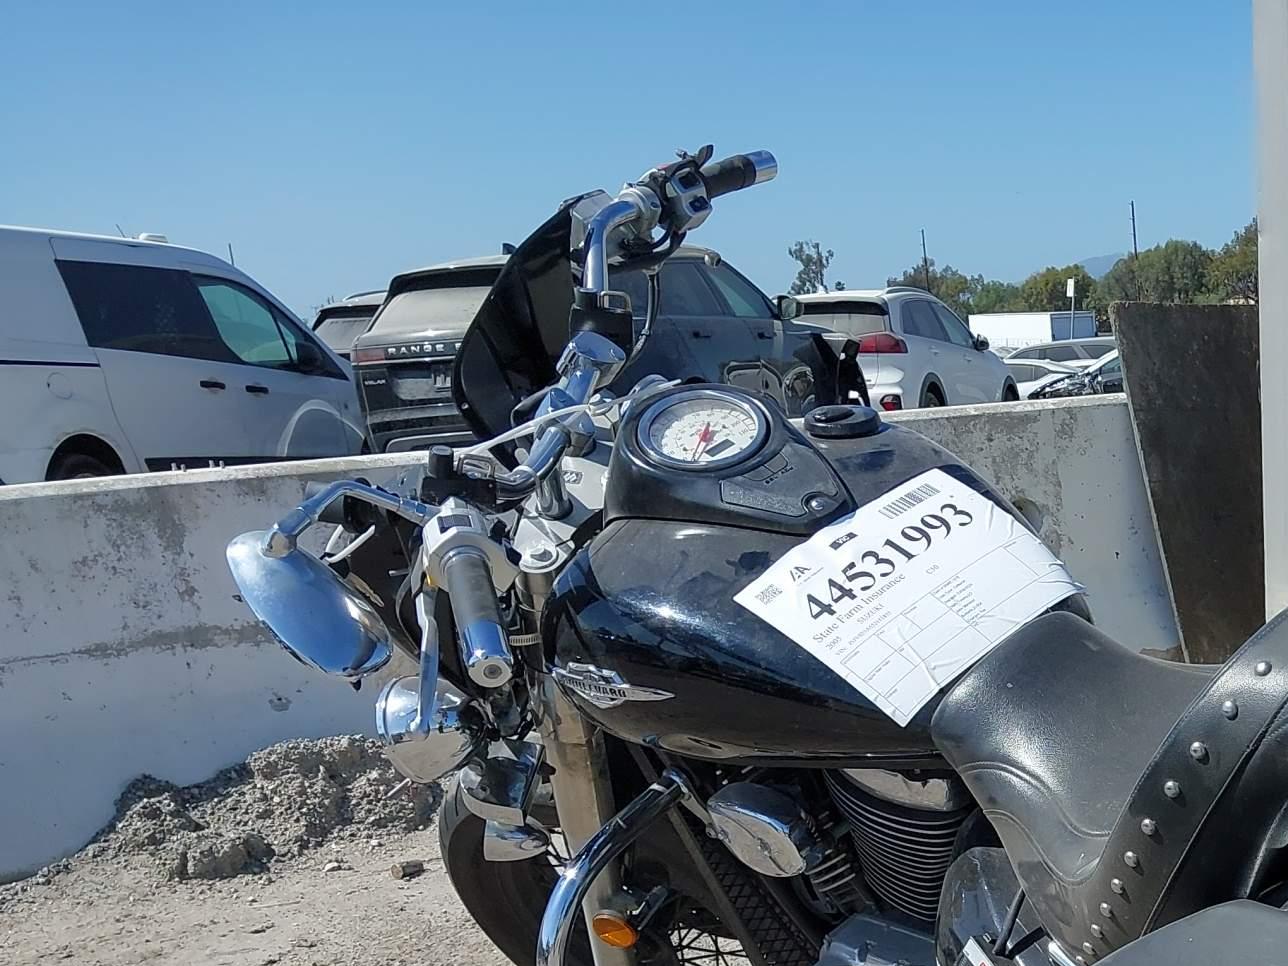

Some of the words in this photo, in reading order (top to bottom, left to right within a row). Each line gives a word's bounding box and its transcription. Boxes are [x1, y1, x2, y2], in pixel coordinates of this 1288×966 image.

[387, 344, 444, 356] RANGE
[806, 503, 973, 620] 44531993
[812, 622, 839, 643] State
[836, 603, 864, 624] Farm
[861, 573, 906, 606] Insurance
